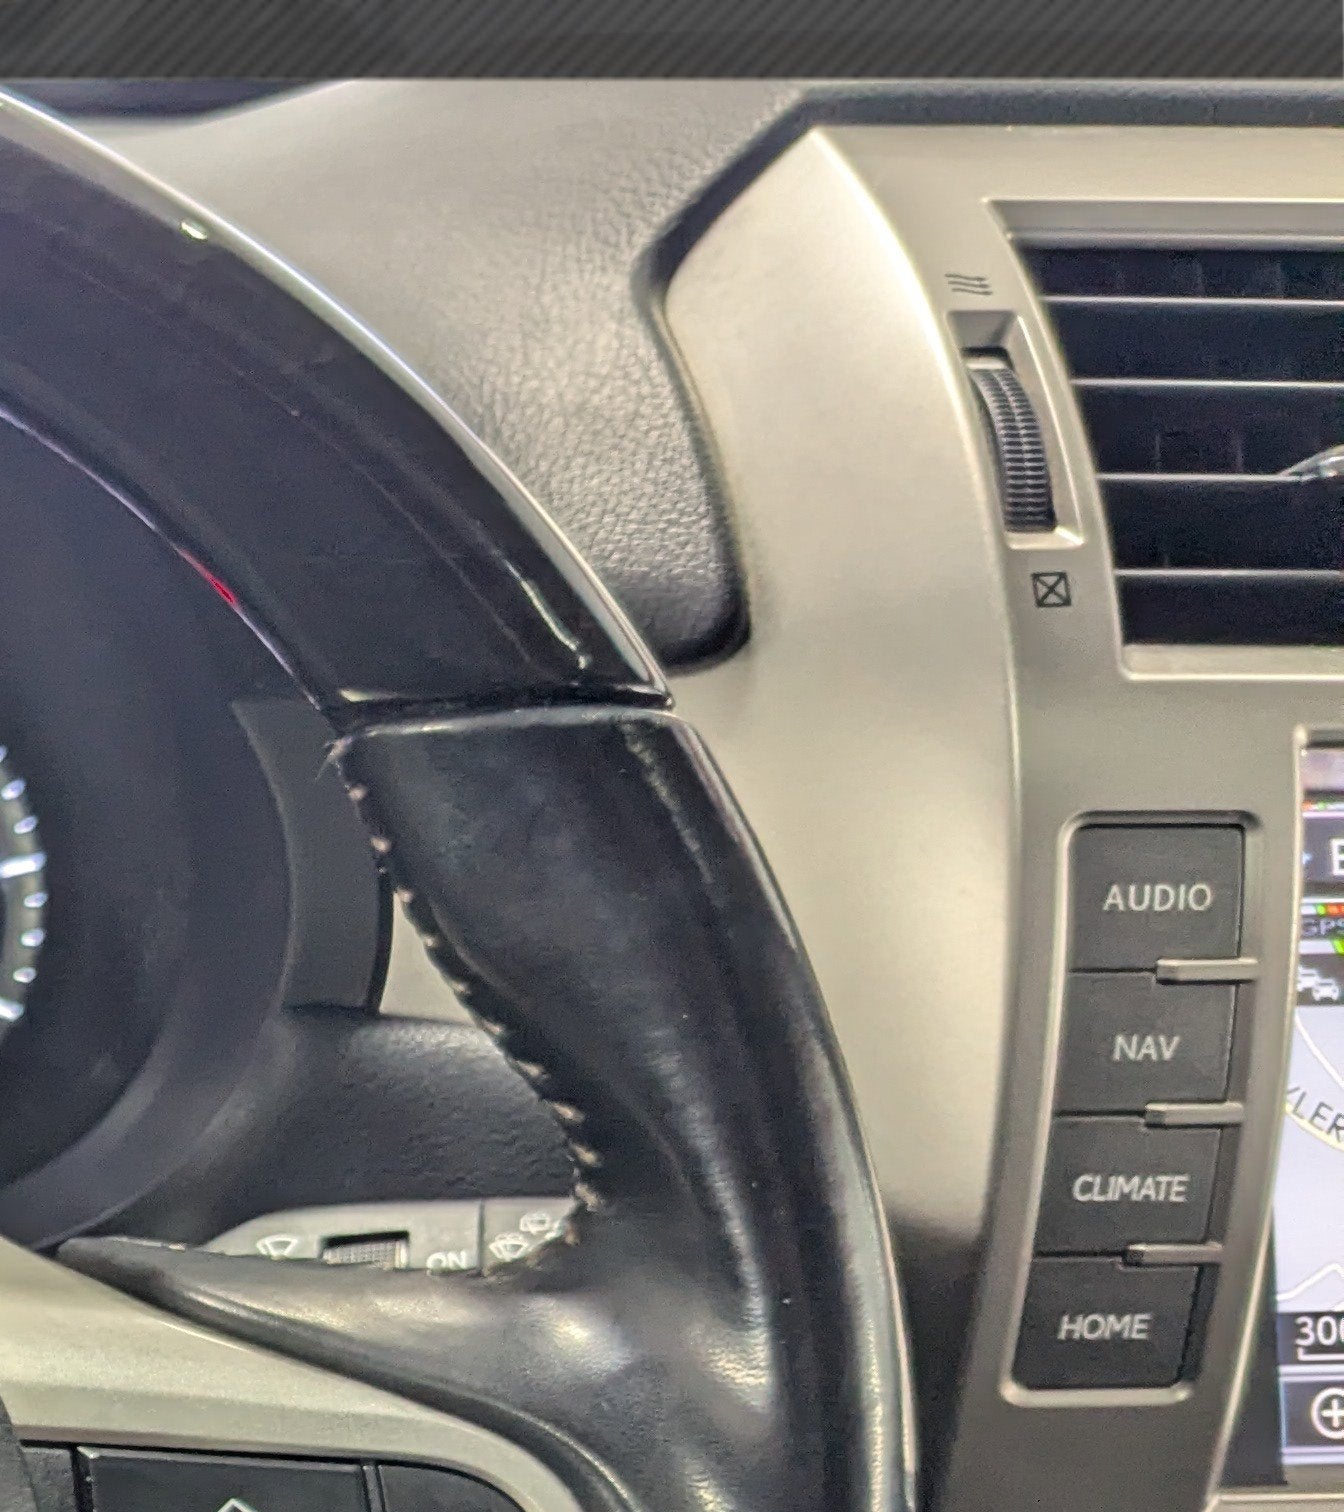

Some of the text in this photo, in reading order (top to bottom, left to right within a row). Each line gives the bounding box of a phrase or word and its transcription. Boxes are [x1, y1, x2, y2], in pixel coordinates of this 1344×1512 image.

[1103, 883, 1213, 913] AUDIO
[1113, 1034, 1180, 1062] NAV
[1072, 1174, 1189, 1203] CLIMATE
[1057, 1312, 1152, 1340] HOME
